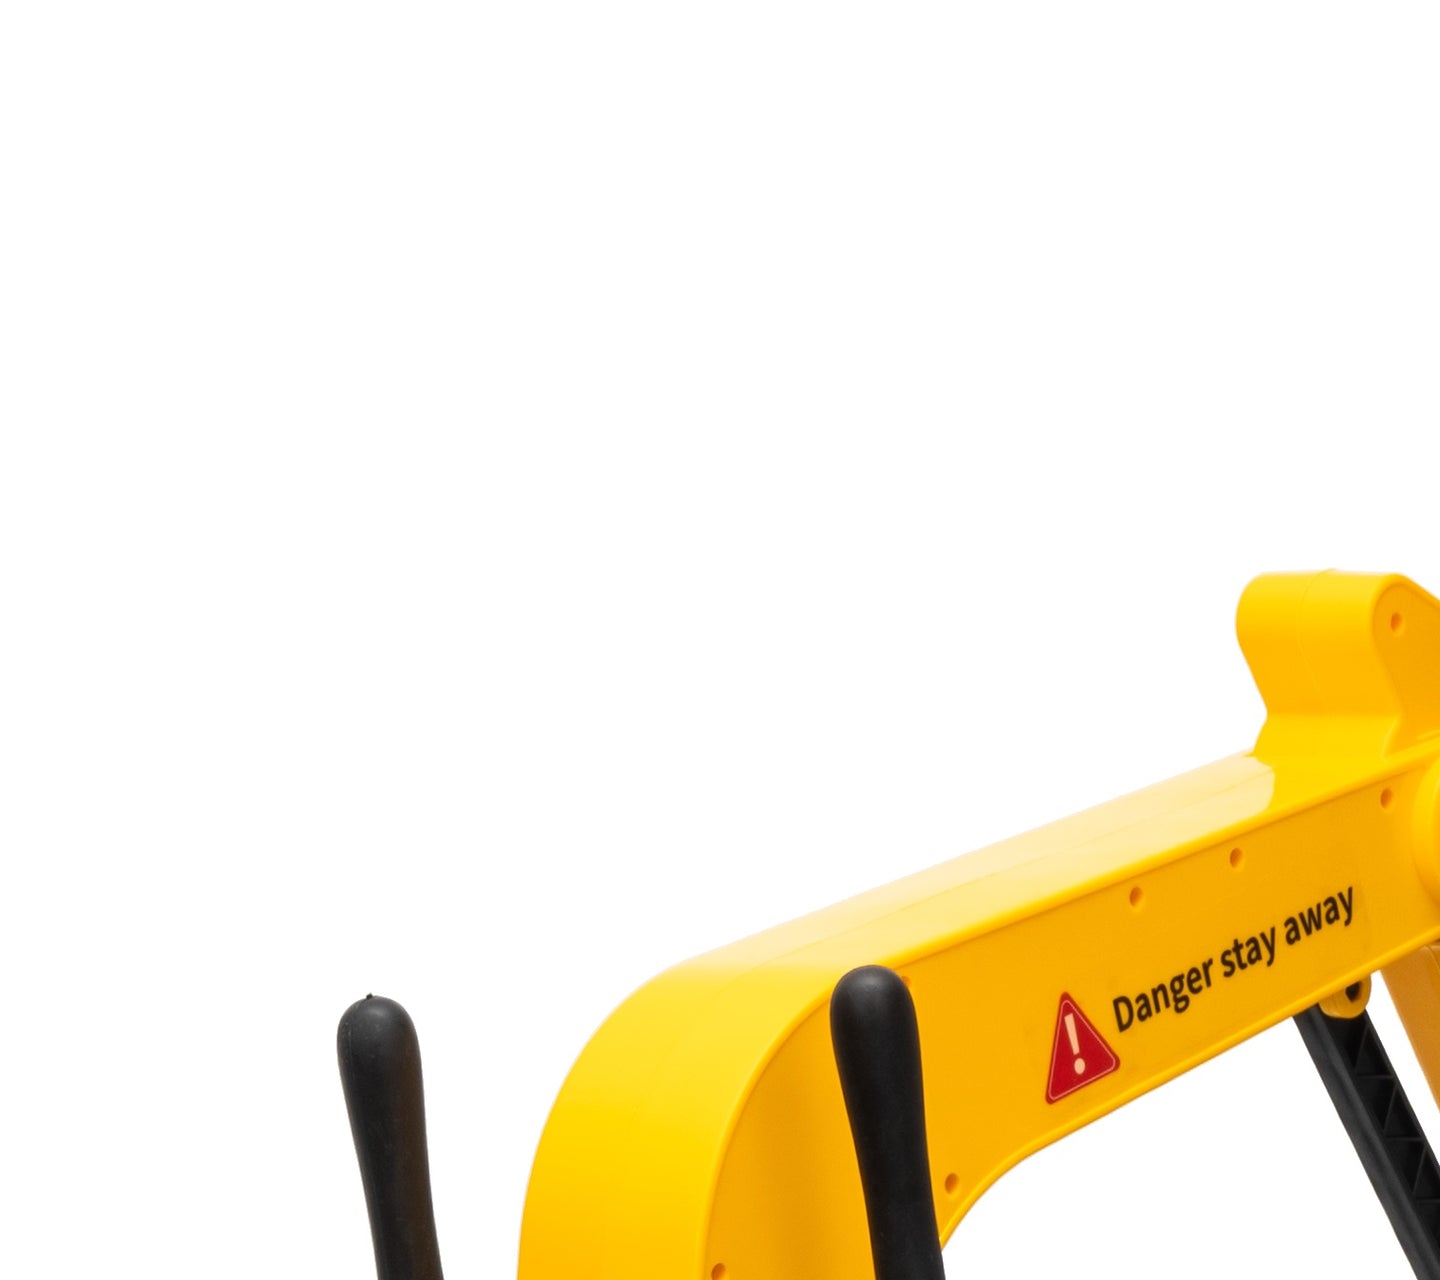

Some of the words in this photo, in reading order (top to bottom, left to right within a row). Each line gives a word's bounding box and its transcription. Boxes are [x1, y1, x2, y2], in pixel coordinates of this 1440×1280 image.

[1112, 957, 1213, 1033] Danger
[1220, 926, 1276, 978] stay
[1284, 886, 1354, 946] away
